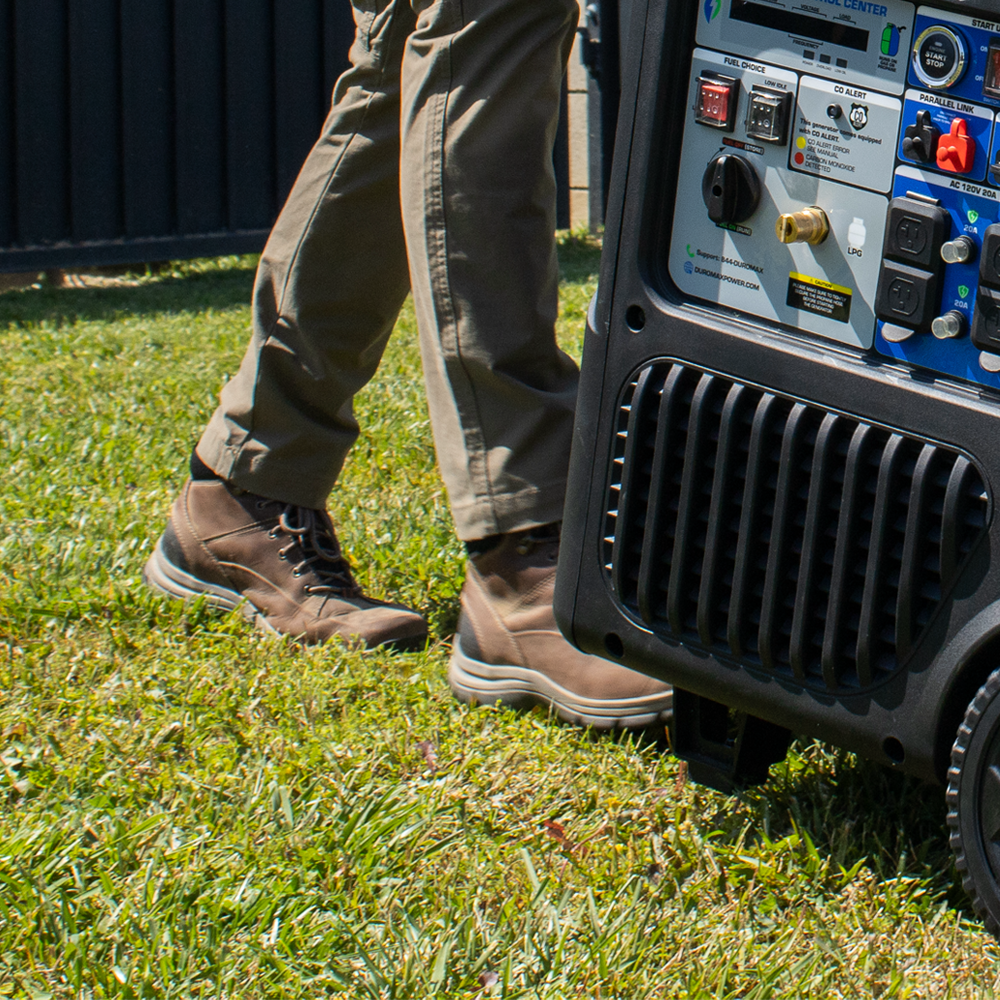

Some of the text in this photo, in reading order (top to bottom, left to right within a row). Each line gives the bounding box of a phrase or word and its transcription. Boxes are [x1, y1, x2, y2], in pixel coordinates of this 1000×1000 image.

[971, 19, 995, 31] START
[925, 50, 947, 62] START
[723, 57, 766, 73] FUEL CHOICE
[925, 58, 945, 69] STOP
[764, 79, 787, 90] LOW IDLE
[834, 85, 867, 99] CO ALERT
[919, 93, 975, 114] PARALLEL LINK
[800, 117, 811, 126] This
[812, 120, 839, 133] generator
[857, 133, 882, 145] equipped
[816, 139, 832, 149] ALERT
[816, 148, 839, 159] MANUAL
[804, 161, 831, 173] DETECTED
[805, 153, 856, 172] CARBON MONOXIDE
[950, 180, 997, 199] AC 120V 20A
[963, 224, 978, 234] 20A
[847, 246, 863, 257] LPG
[696, 249, 764, 274] Support: 844-DUROMAX
[694, 266, 760, 291] DUROMAXPOWER.COM
[815, 280, 833, 288] CAUTION
[954, 299, 968, 309] 20A
